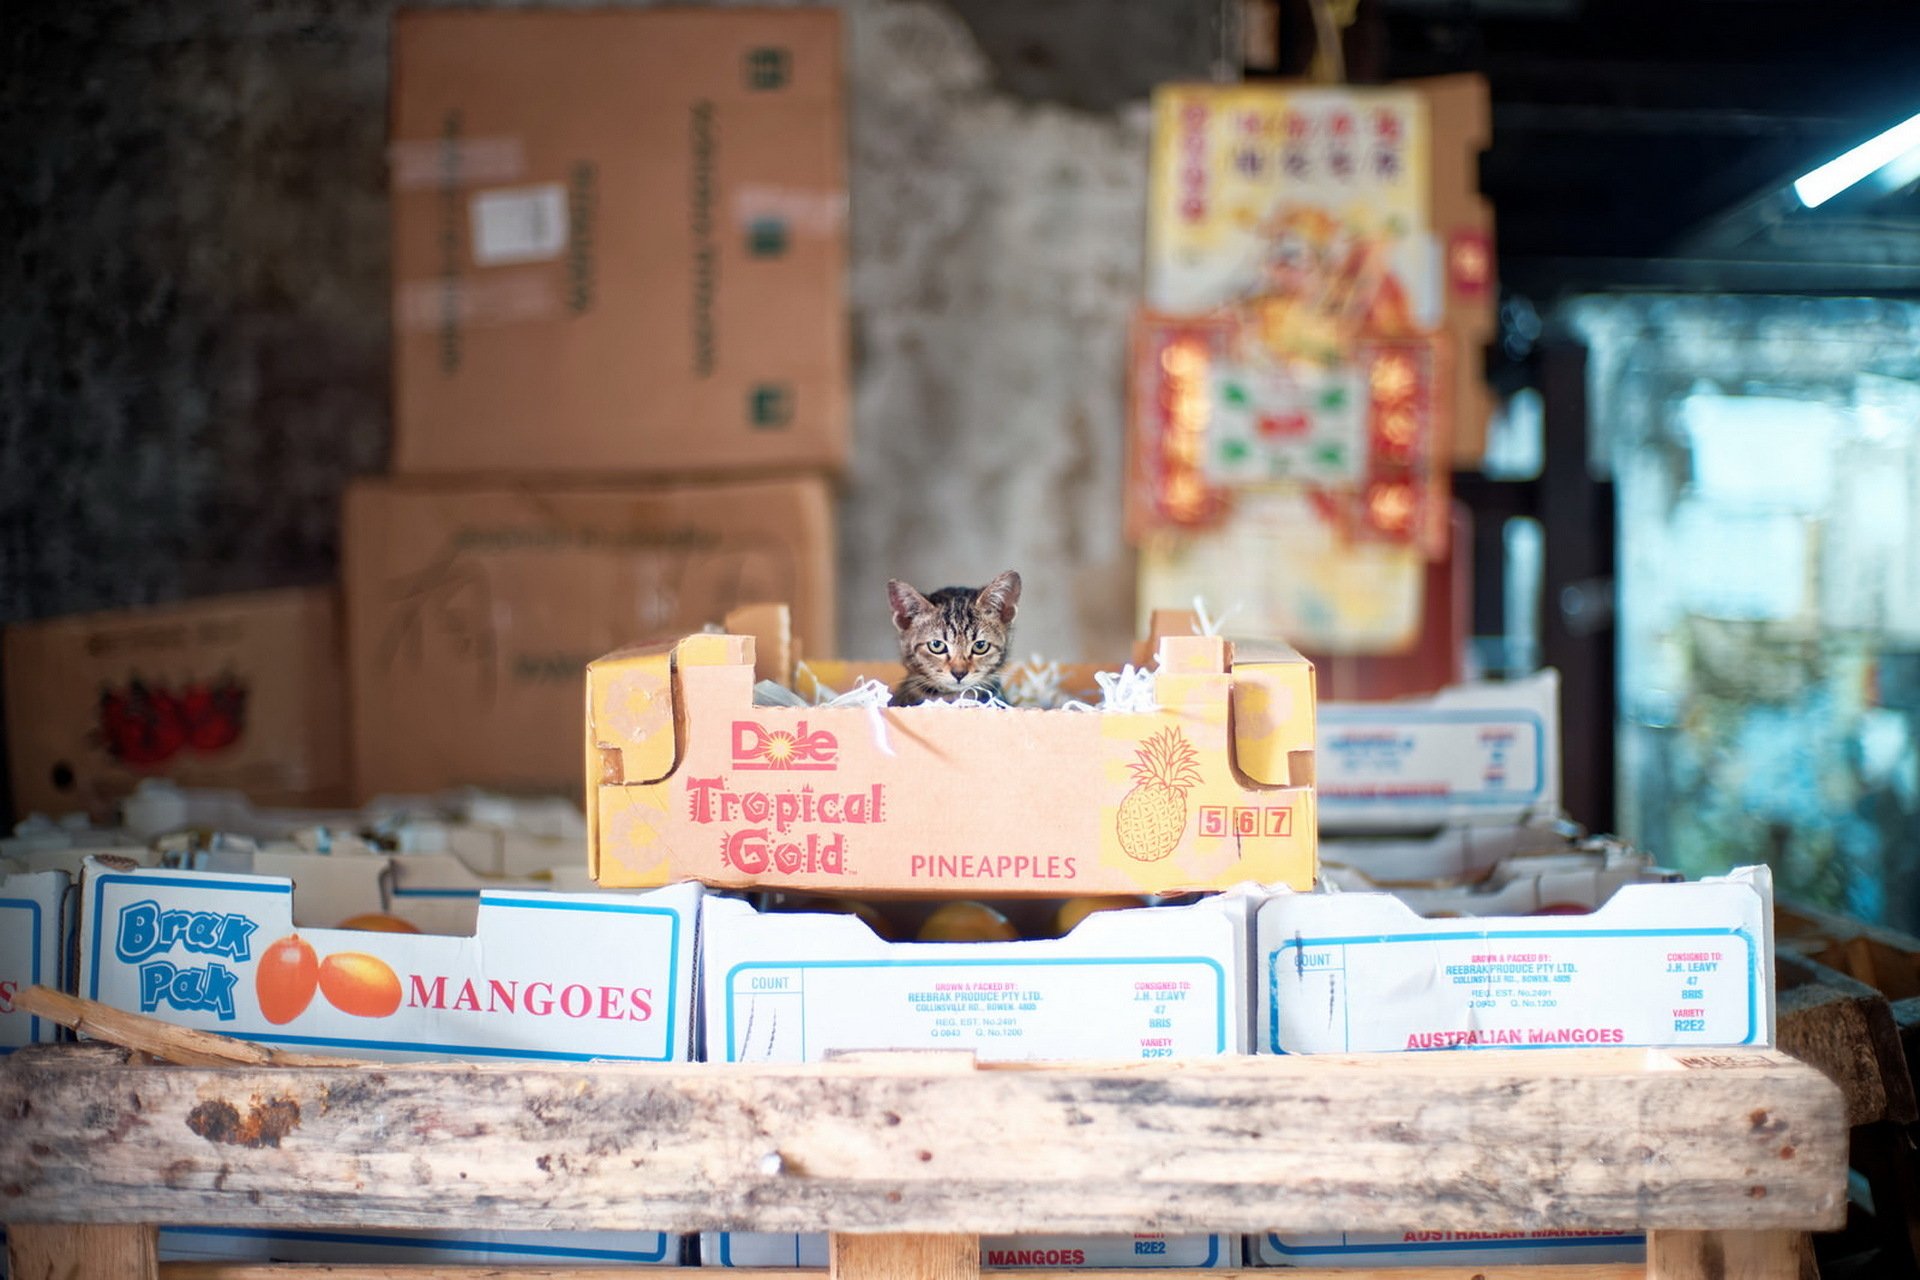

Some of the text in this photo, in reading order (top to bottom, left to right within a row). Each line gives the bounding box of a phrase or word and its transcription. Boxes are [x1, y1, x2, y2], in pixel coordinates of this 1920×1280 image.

[732, 721, 838, 762] Dole
[686, 775, 885, 833] Tropical
[1206, 810, 1287, 833] 5 6 7
[721, 828, 848, 875] Gold
[911, 855, 1077, 879] PINEAPPLES
[115, 899, 259, 963] Brak
[1294, 953, 1331, 967] COUNT
[1506, 953, 1537, 962] PACKED
[1667, 952, 1709, 961] CONSIGNED
[1446, 963, 1578, 975] REEBRAK PRODUCE PTY LTD.
[1687, 962, 1718, 973] LEAVY
[751, 976, 789, 990] COUNT
[973, 982, 1003, 991] PACKED
[1134, 981, 1177, 990] CONSIGNED
[1686, 976, 1698, 986] 47
[139, 960, 239, 1021] Pak
[908, 991, 1043, 1002] REEBRAK PRODUCE PTY LTD.
[1155, 990, 1186, 1001] LEAVY
[1681, 989, 1704, 1000] BRIS
[407, 974, 653, 1022] MANGOES
[1153, 1004, 1166, 1015] 47
[1672, 1008, 1705, 1018] VARIETY
[1148, 1018, 1172, 1029] BRIS
[1674, 1019, 1706, 1032] R2E2
[1140, 1038, 1173, 1047] VARIETY
[1406, 1028, 1625, 1049] AUSTRALIAN MANGOES
[1134, 1241, 1167, 1255] R2E2
[987, 1249, 1086, 1266] MANGOES
